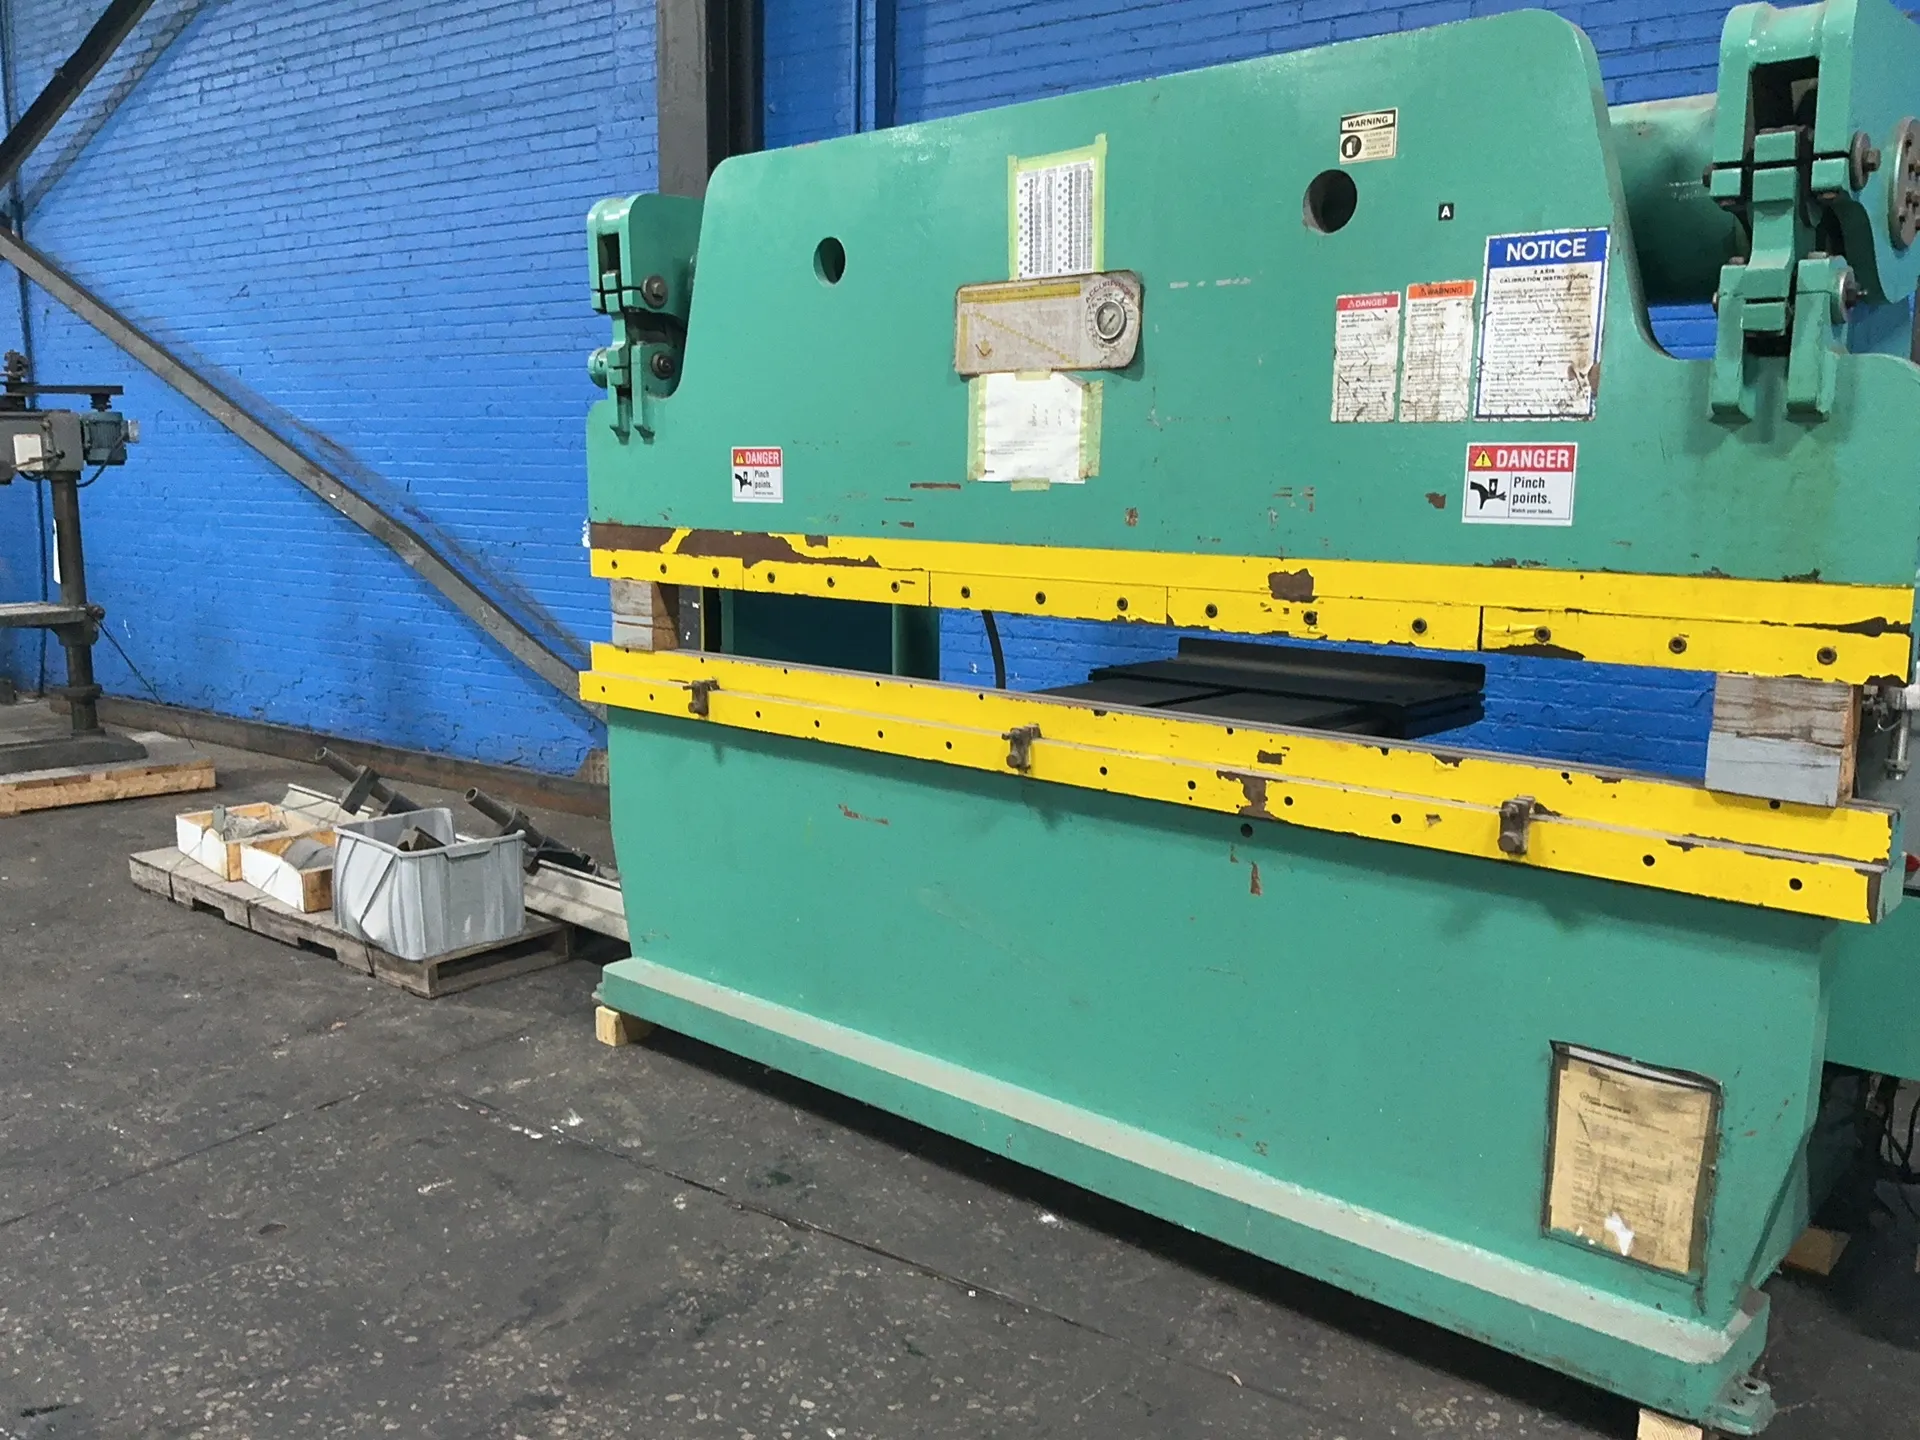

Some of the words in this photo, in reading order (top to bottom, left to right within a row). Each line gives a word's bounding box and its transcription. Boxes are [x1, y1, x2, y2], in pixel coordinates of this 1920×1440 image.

[1347, 115, 1389, 129] WARNING
[1441, 205, 1451, 218] A
[1506, 238, 1587, 262] NOTICE
[1499, 276, 1541, 284] CALIBRATION
[1427, 285, 1463, 296] WARNING
[1355, 298, 1388, 307] DANGER
[745, 451, 780, 465] DANGER
[1496, 449, 1570, 468] DANGER
[755, 470, 770, 478] Pinch
[1513, 476, 1545, 488] Pinch
[1512, 492, 1552, 506] points.
